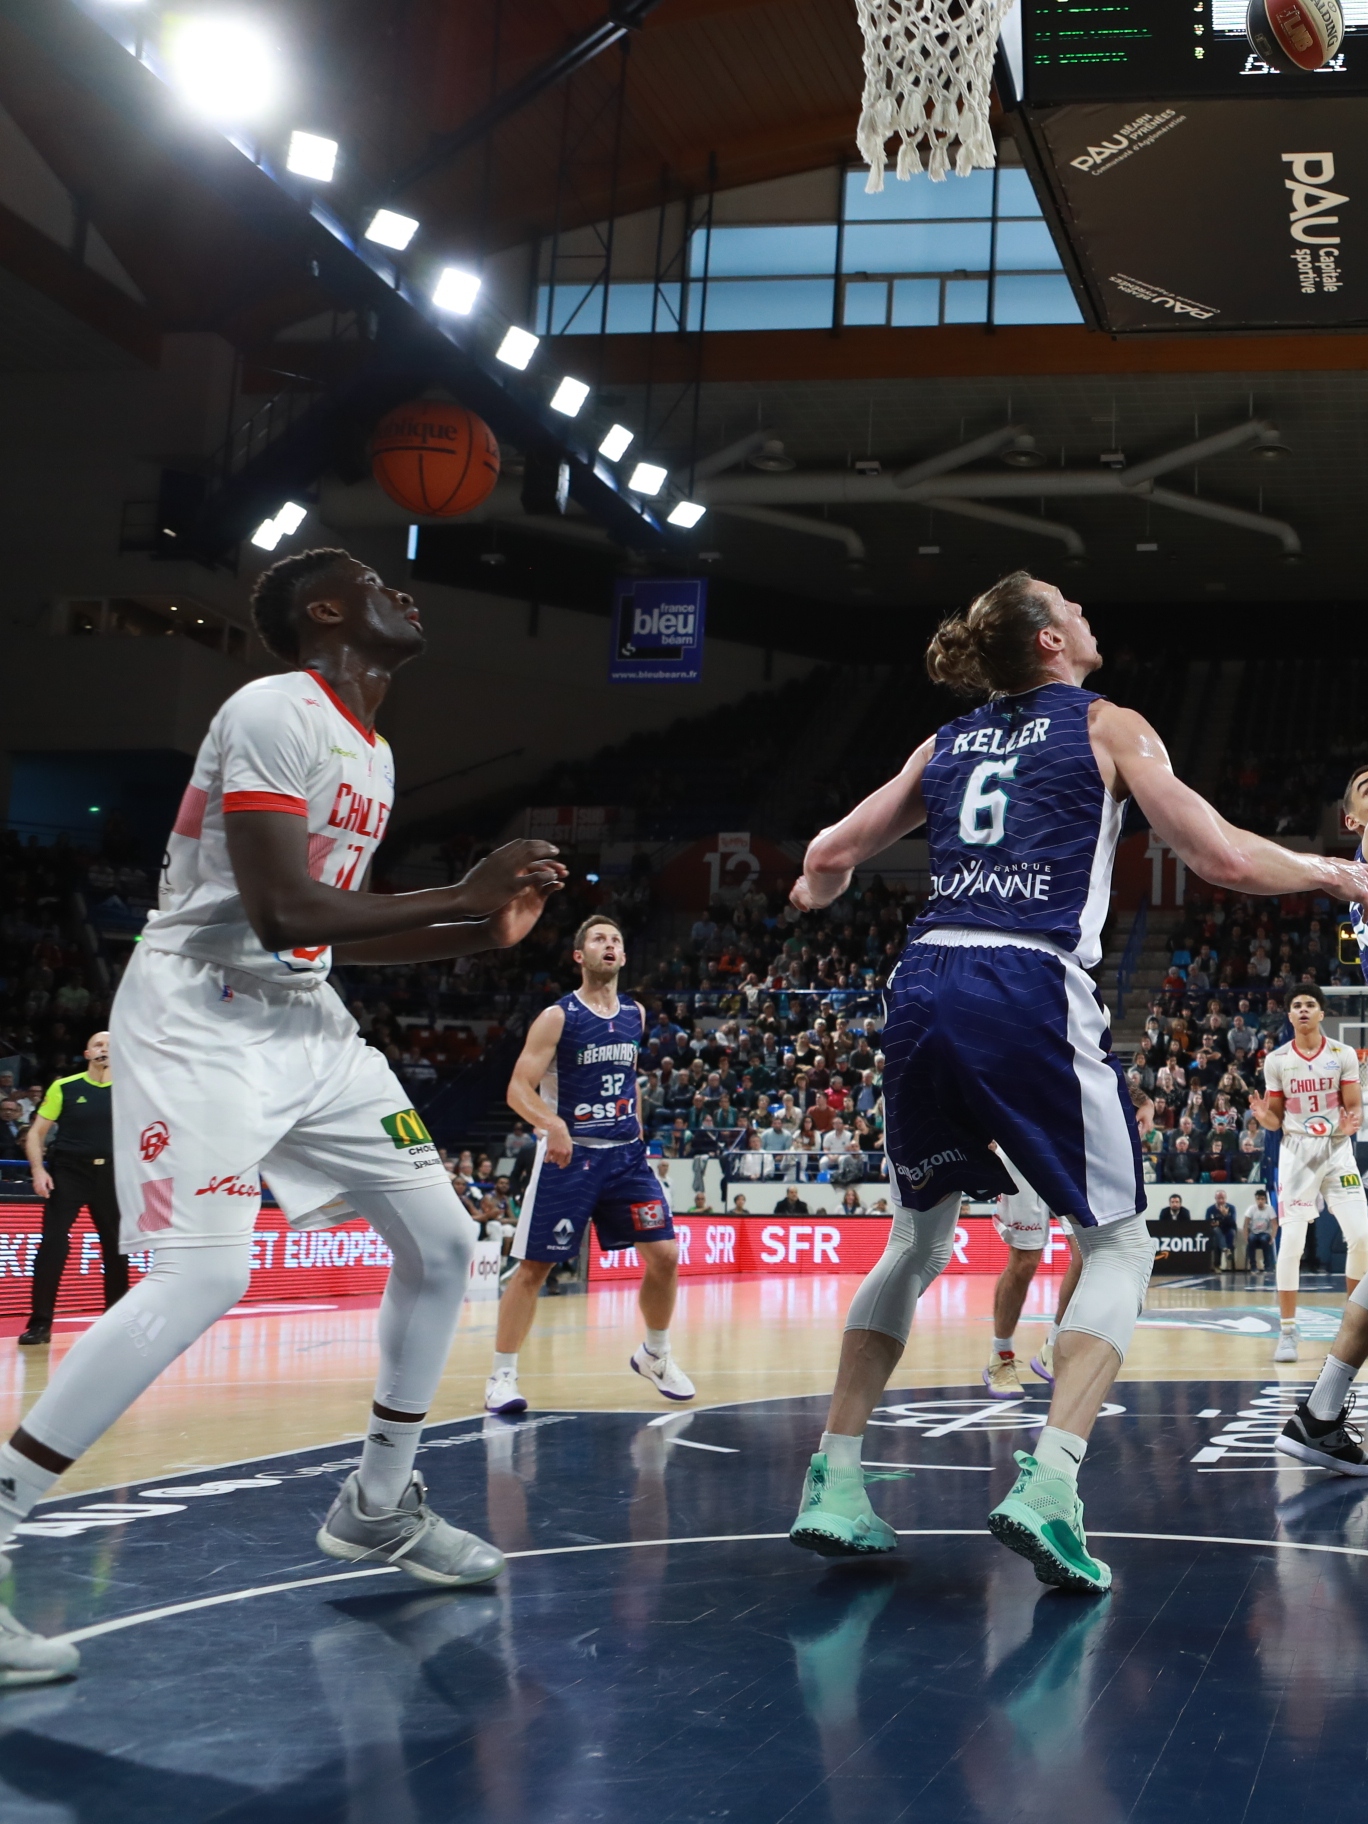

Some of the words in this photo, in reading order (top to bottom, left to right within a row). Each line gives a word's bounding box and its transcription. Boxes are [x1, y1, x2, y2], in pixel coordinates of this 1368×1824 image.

[1311, 0, 1338, 48] ALDING
[1119, 113, 1153, 136] BÉARN
[1129, 108, 1176, 140] PYRÉNÉES
[1070, 133, 1129, 172] PAU
[1281, 152, 1350, 245] PAU
[1290, 248, 1320, 294] sportive
[1315, 247, 1343, 292] Capitale
[1151, 297, 1214, 319] PAU
[633, 609, 695, 635] bleu
[660, 603, 695, 613] france
[661, 634, 693, 645] béarn
[952, 717, 1051, 756] KELLER
[958, 754, 1019, 847] 6
[928, 859, 1051, 901] UYANNE
[993, 861, 1051, 872] BANQUE
[600, 1072, 625, 1097] 32
[1290, 1077, 1335, 1094] CHOLET
[1308, 1095, 1319, 1113] 3
[249, 1232, 276, 1270] ET
[284, 1228, 394, 1269] EUROPÉE
[705, 1225, 736, 1264] SFR
[760, 1225, 840, 1264] SFR
[478, 1256, 499, 1281] dpd
